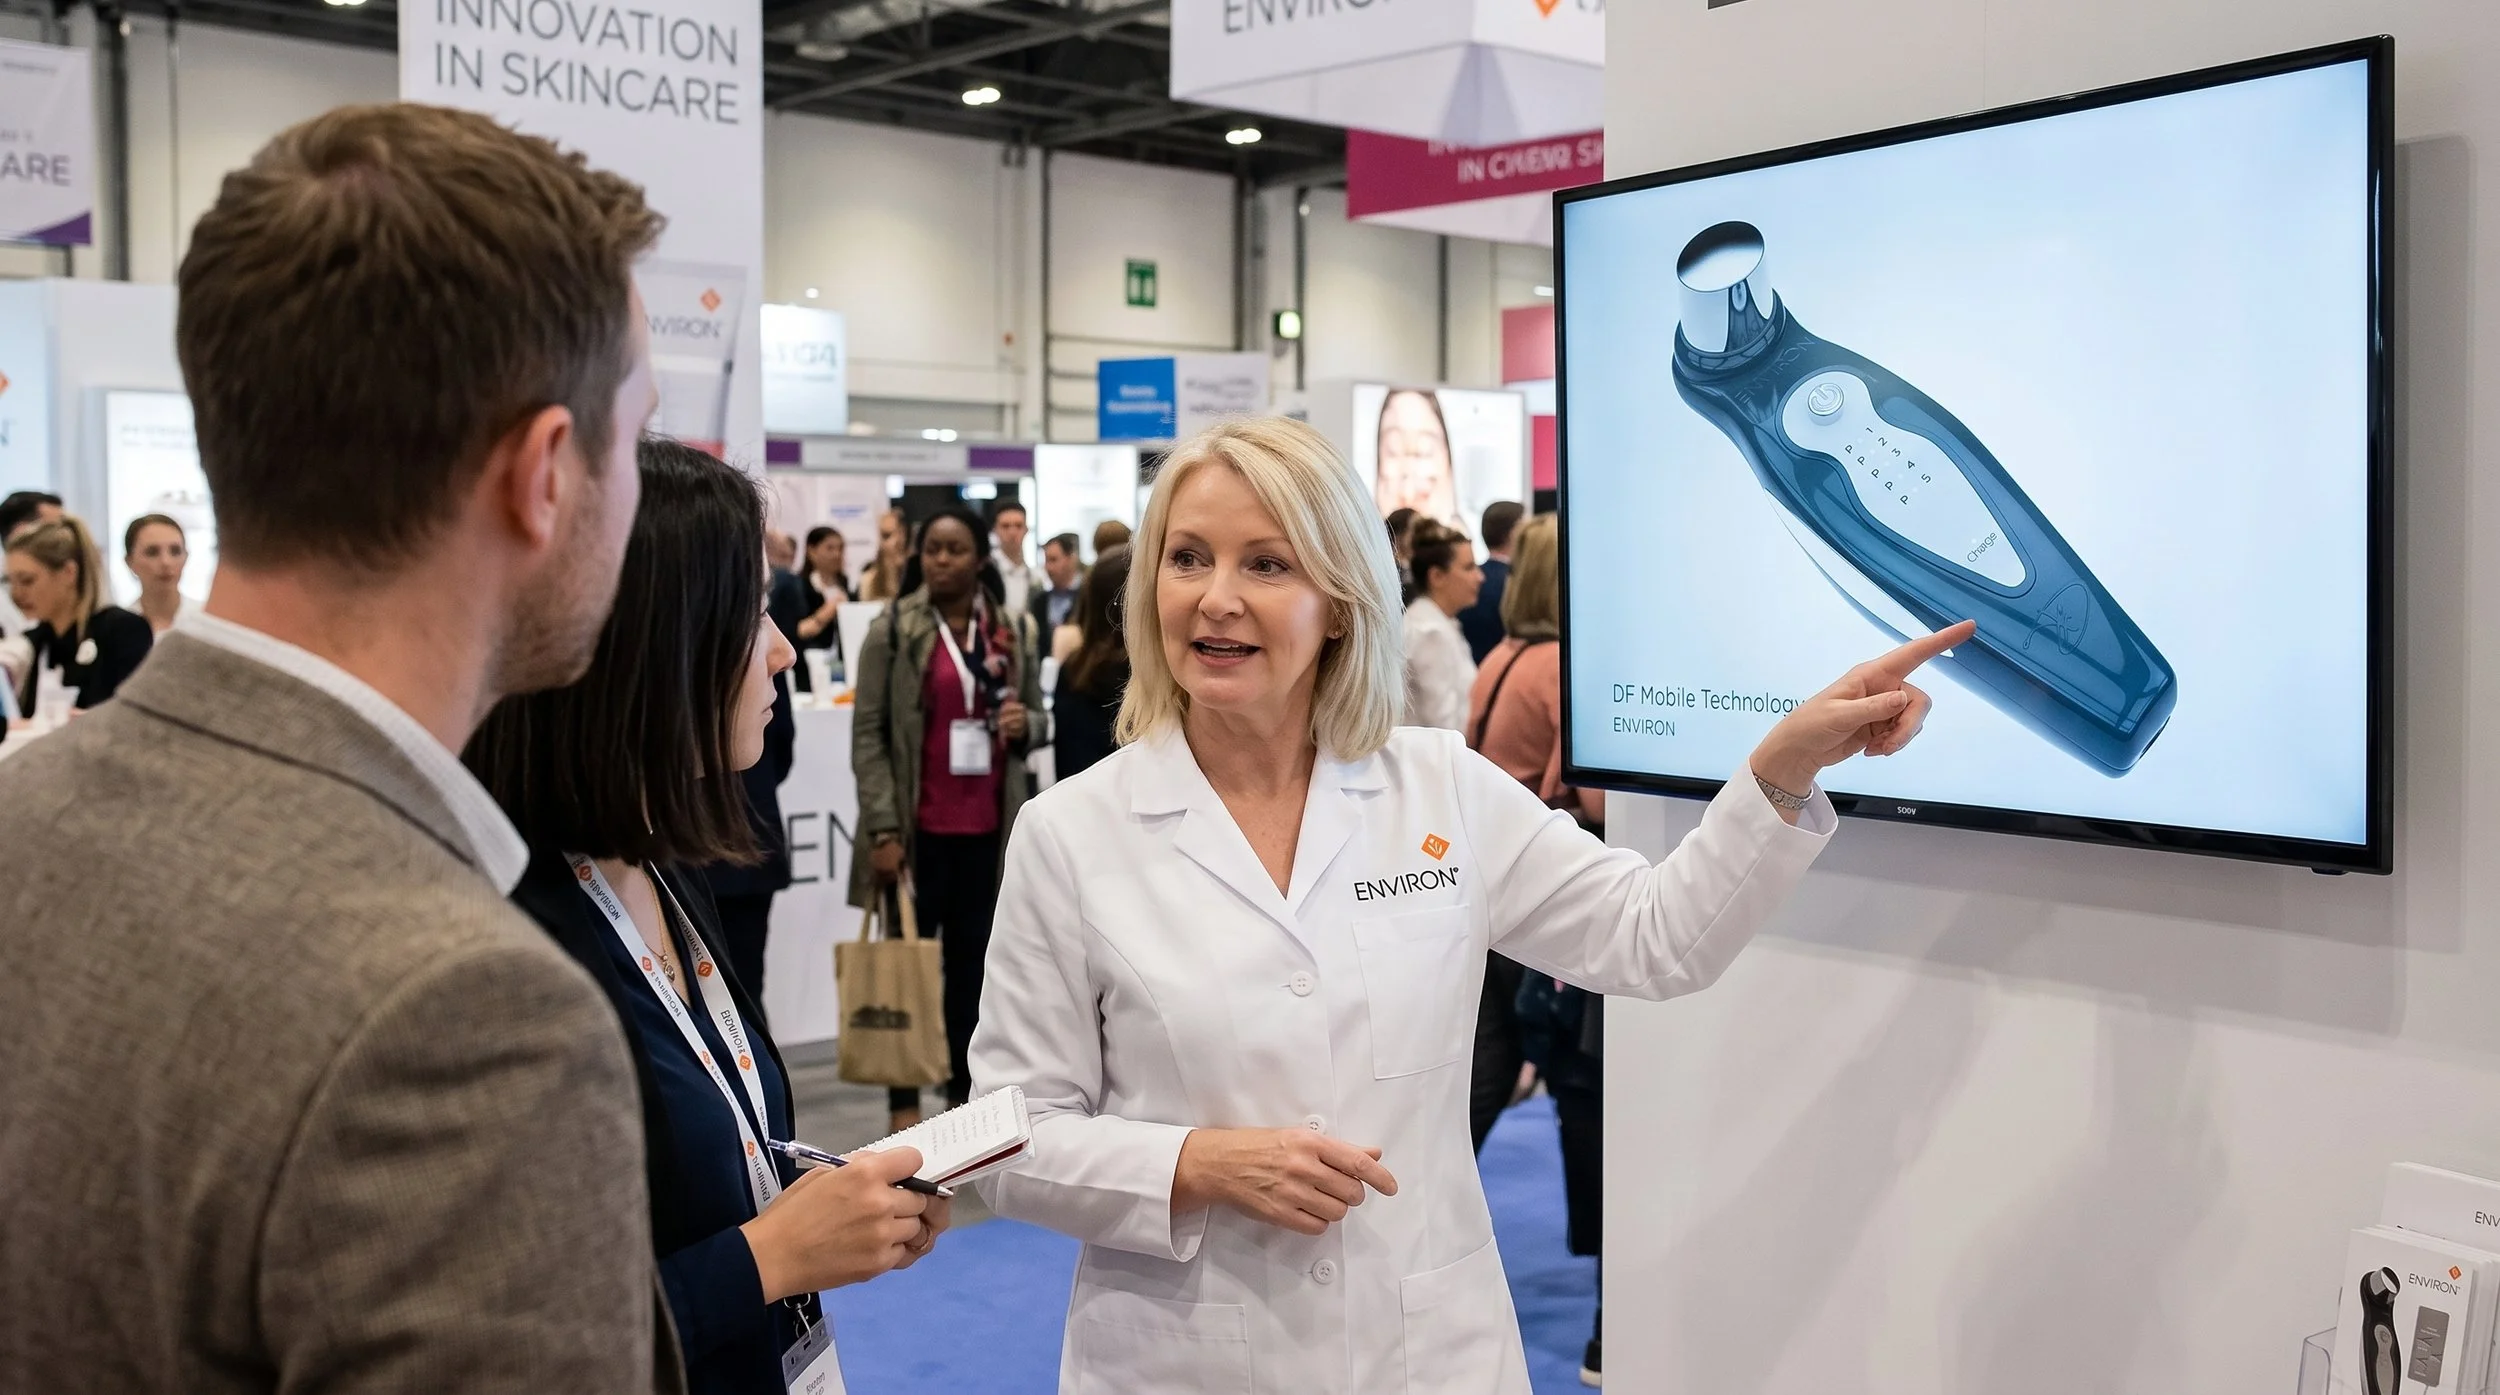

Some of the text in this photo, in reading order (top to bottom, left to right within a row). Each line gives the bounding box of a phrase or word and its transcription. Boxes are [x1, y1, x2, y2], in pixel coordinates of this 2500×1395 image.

[437, 0, 738, 66] INNOVATION
[437, 41, 740, 124] IN SKINCARE
[645, 315, 721, 339] NVIRON
[1845, 444, 1854, 454] P
[1857, 437, 1888, 466] P 2
[1871, 448, 1901, 479] P 3
[1884, 460, 1916, 491] P 4
[1900, 473, 1932, 505] P 5
[1613, 684, 1635, 704] DF
[1641, 686, 1696, 709] Mobile
[1613, 717, 1676, 737] ENVIRON
[2474, 1211, 2500, 1227] ENV
